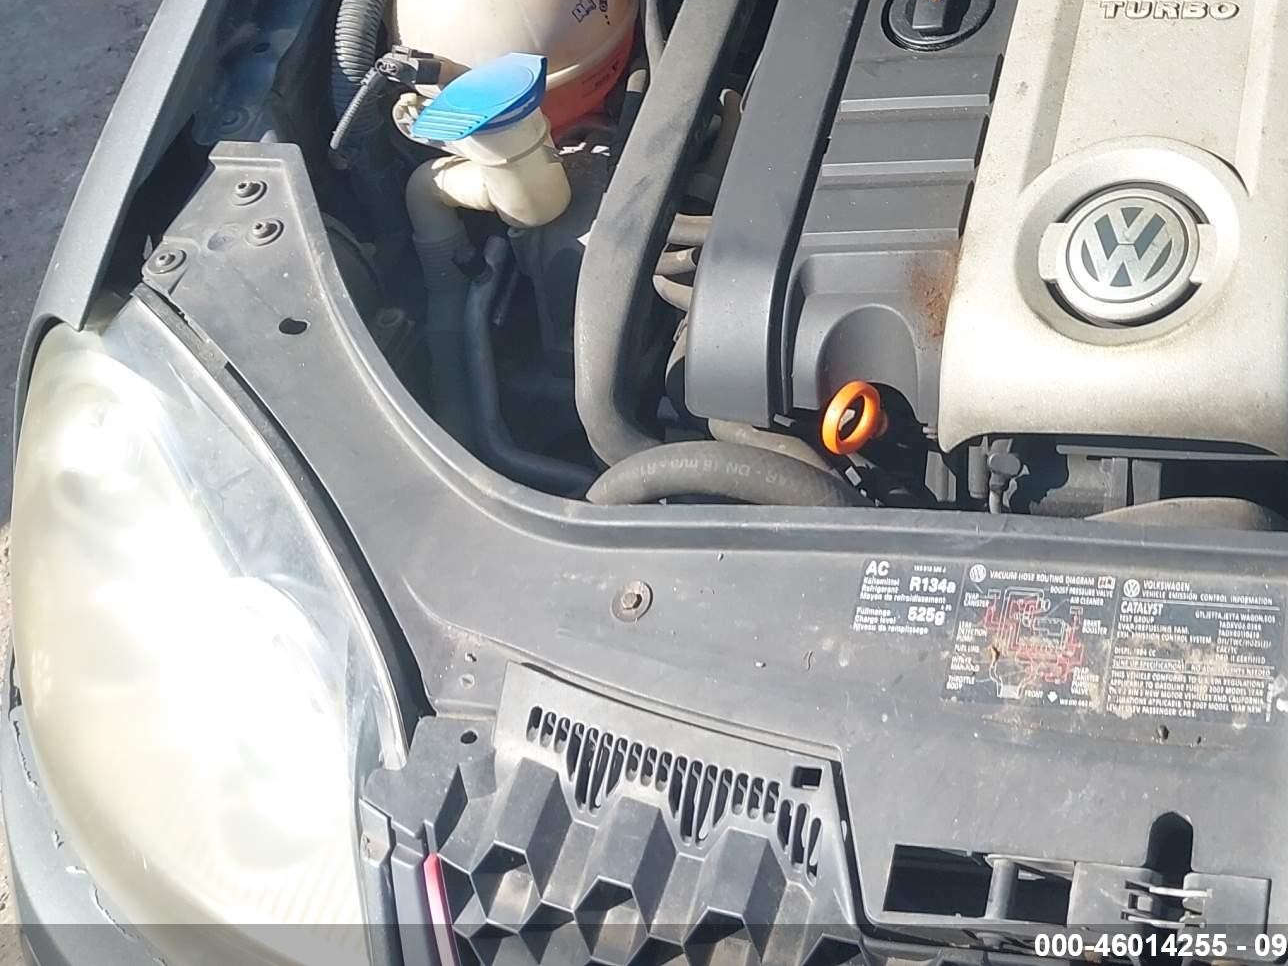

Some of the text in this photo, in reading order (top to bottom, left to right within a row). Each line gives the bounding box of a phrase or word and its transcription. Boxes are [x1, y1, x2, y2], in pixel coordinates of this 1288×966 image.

[1100, 0, 1240, 20] TURBO
[865, 560, 890, 577] AC
[909, 576, 956, 594] R134a
[990, 570, 1018, 580] VACUUM
[1036, 573, 1065, 583] ROUTING
[1065, 575, 1096, 585] DIAGRAM
[1142, 589, 1273, 605] VEHICLE EMISSION CONTROL INFORMATION
[1120, 600, 1164, 616] CATALYST
[908, 606, 946, 626] 525g
[1119, 613, 1155, 624] TEST GROUP
[1189, 635, 1212, 645] SYSTEM
[1236, 654, 1266, 664] CERTIFIED
[1126, 671, 1152, 681] VEHICLE
[1155, 681, 1186, 690] GASOLINE
[1225, 686, 1246, 696] MODEL
[1160, 690, 1183, 699] MOTOR
